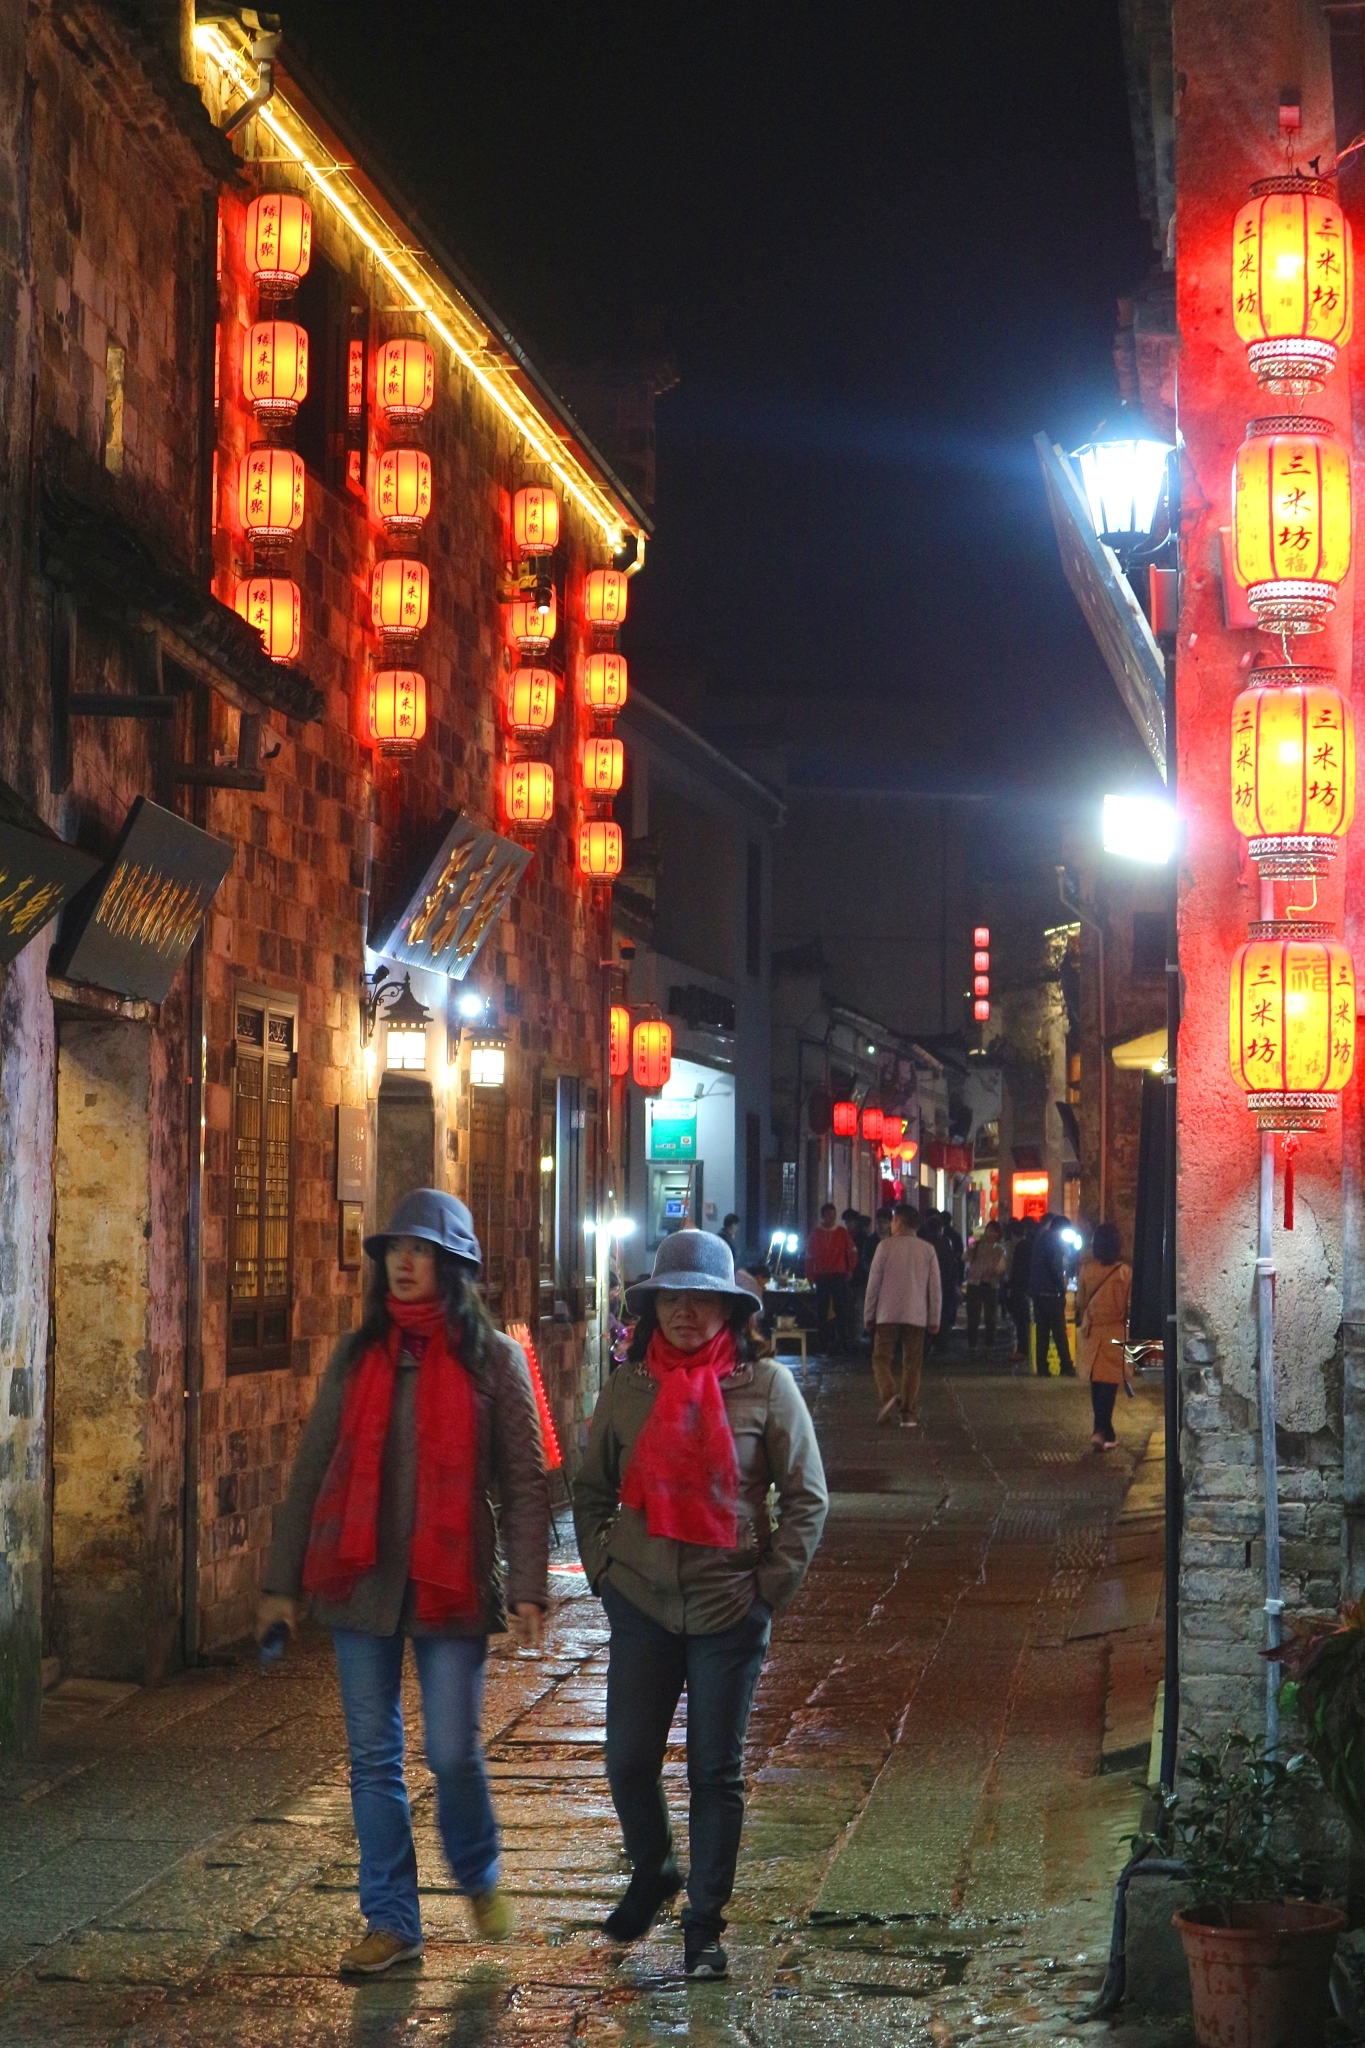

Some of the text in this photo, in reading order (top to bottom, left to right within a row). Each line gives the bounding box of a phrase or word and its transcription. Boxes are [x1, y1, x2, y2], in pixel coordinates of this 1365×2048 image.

[1237, 220, 1257, 314] 三米坊
[1312, 217, 1340, 311] 三米坊
[1278, 455, 1312, 551] 三米坊
[1235, 710, 1254, 808] 三米坊
[1309, 709, 1338, 806] 三米坊
[1247, 965, 1277, 1063] 三米坊
[1334, 966, 1352, 1063] 三米坊
